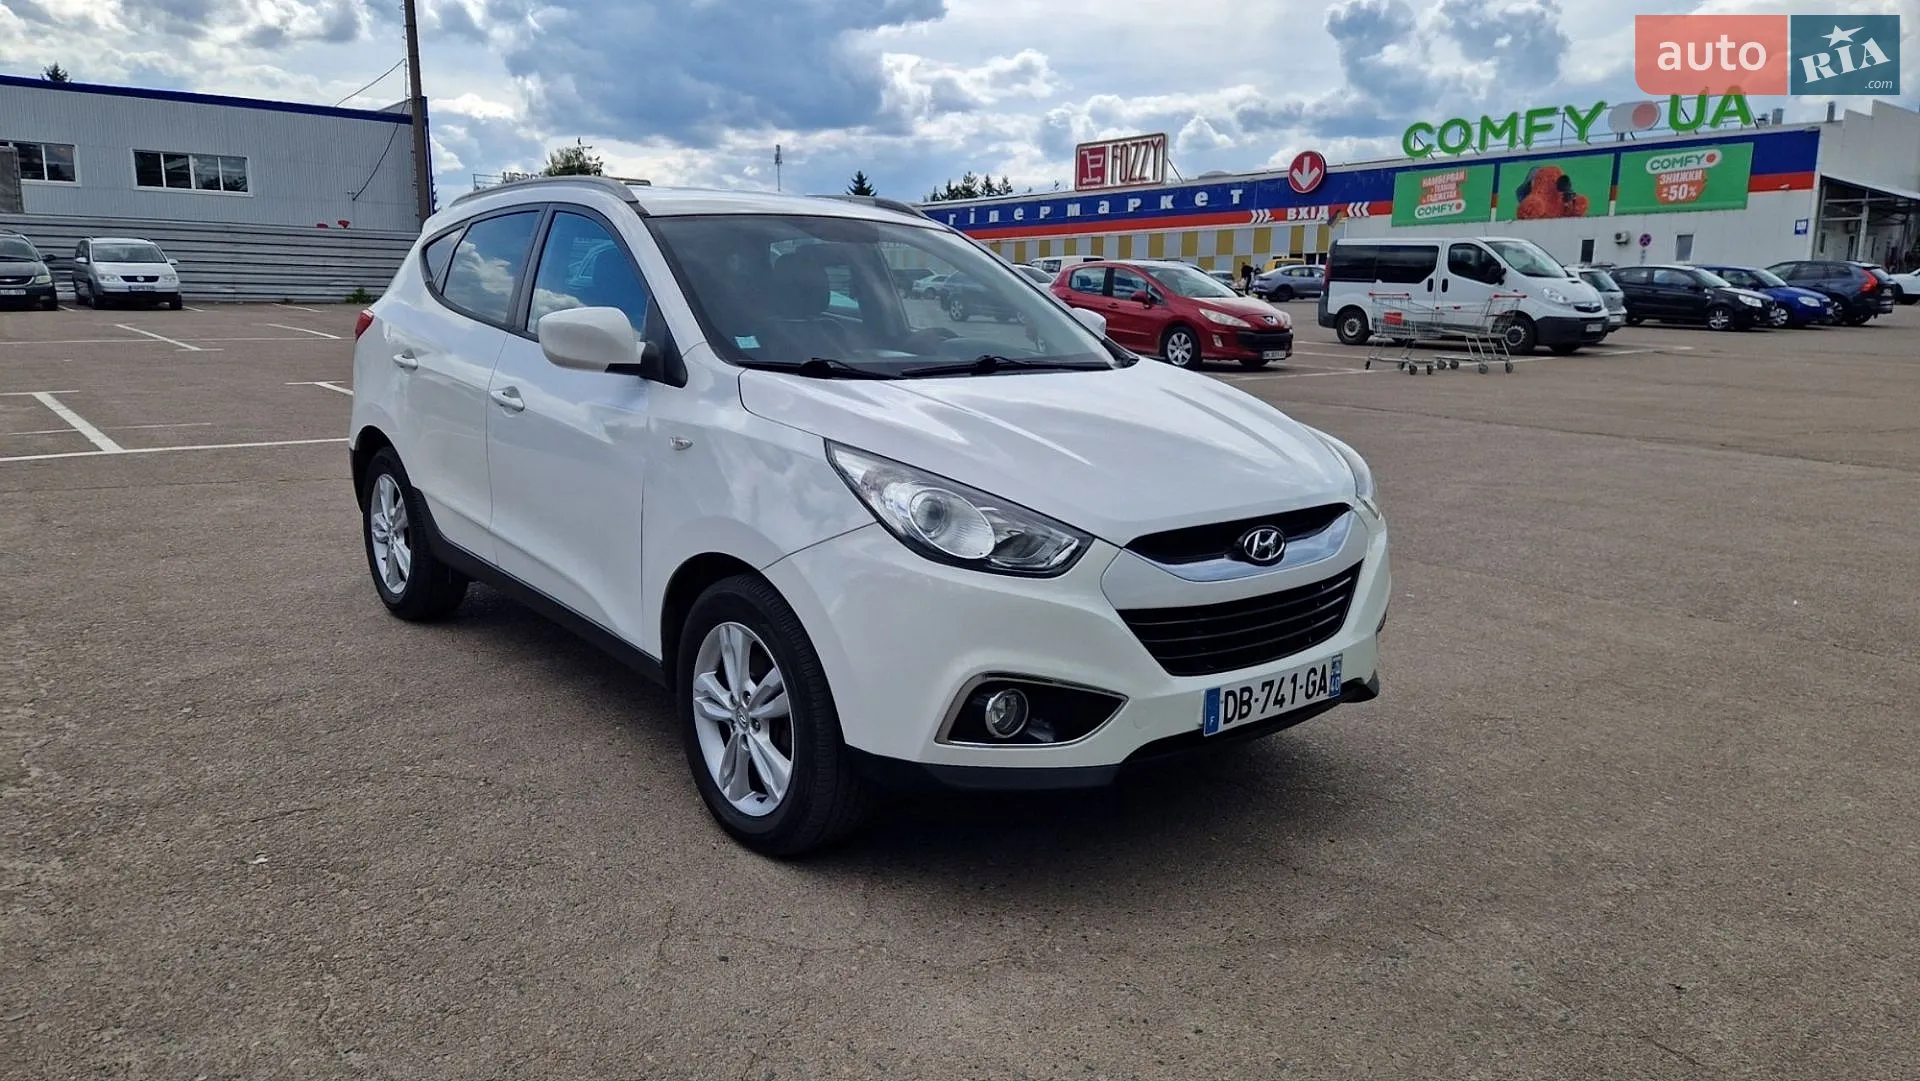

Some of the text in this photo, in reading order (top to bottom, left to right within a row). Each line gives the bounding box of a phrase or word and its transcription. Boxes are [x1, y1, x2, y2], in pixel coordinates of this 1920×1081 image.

[1402, 85, 1754, 158] COMFY UA
[1111, 138, 1163, 185] FOZZY
[1650, 154, 1706, 170] COMFY
[1659, 169, 1703, 185] ЗНИЖКИ
[1287, 205, 1329, 220] ВХІД
[1417, 203, 1455, 217] COMFY
[1223, 664, 1327, 724] DB-741-GA
